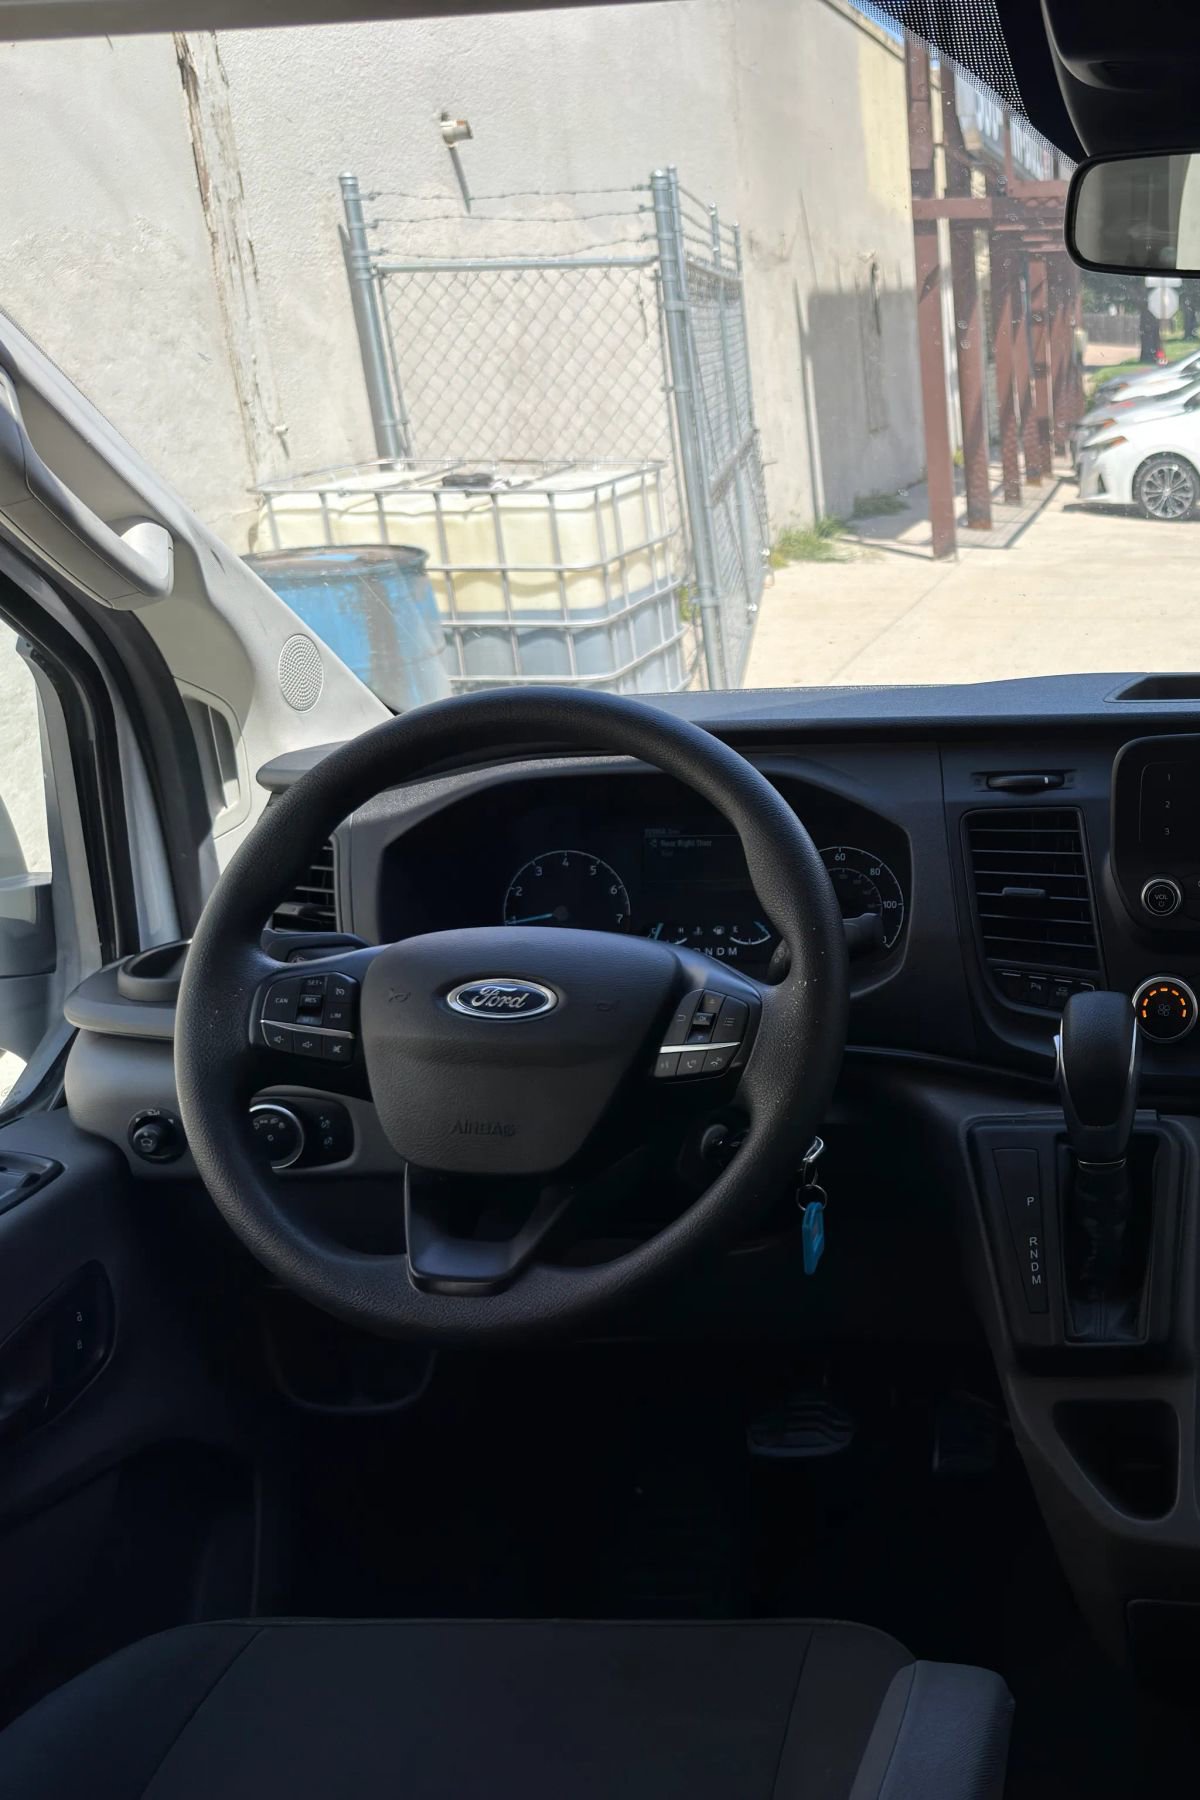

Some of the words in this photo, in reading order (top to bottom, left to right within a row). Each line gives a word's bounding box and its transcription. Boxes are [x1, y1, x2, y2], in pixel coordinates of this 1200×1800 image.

[834, 852, 846, 861] 60
[562, 857, 569, 867] 4
[535, 865, 543, 876] 3
[589, 865, 597, 876] 5
[869, 867, 881, 876] 80
[515, 886, 523, 896] 2
[610, 885, 618, 895] 6
[883, 900, 898, 909] 100
[616, 913, 624, 924] 7
[716, 947, 724, 956] D
[728, 947, 738, 955] M
[471, 986, 530, 1009] Ford
[1026, 1196, 1035, 1206] P
[1029, 1236, 1039, 1246] R
[1030, 1249, 1039, 1259] N
[1031, 1262, 1040, 1272] D
[1032, 1275, 1042, 1285] M
